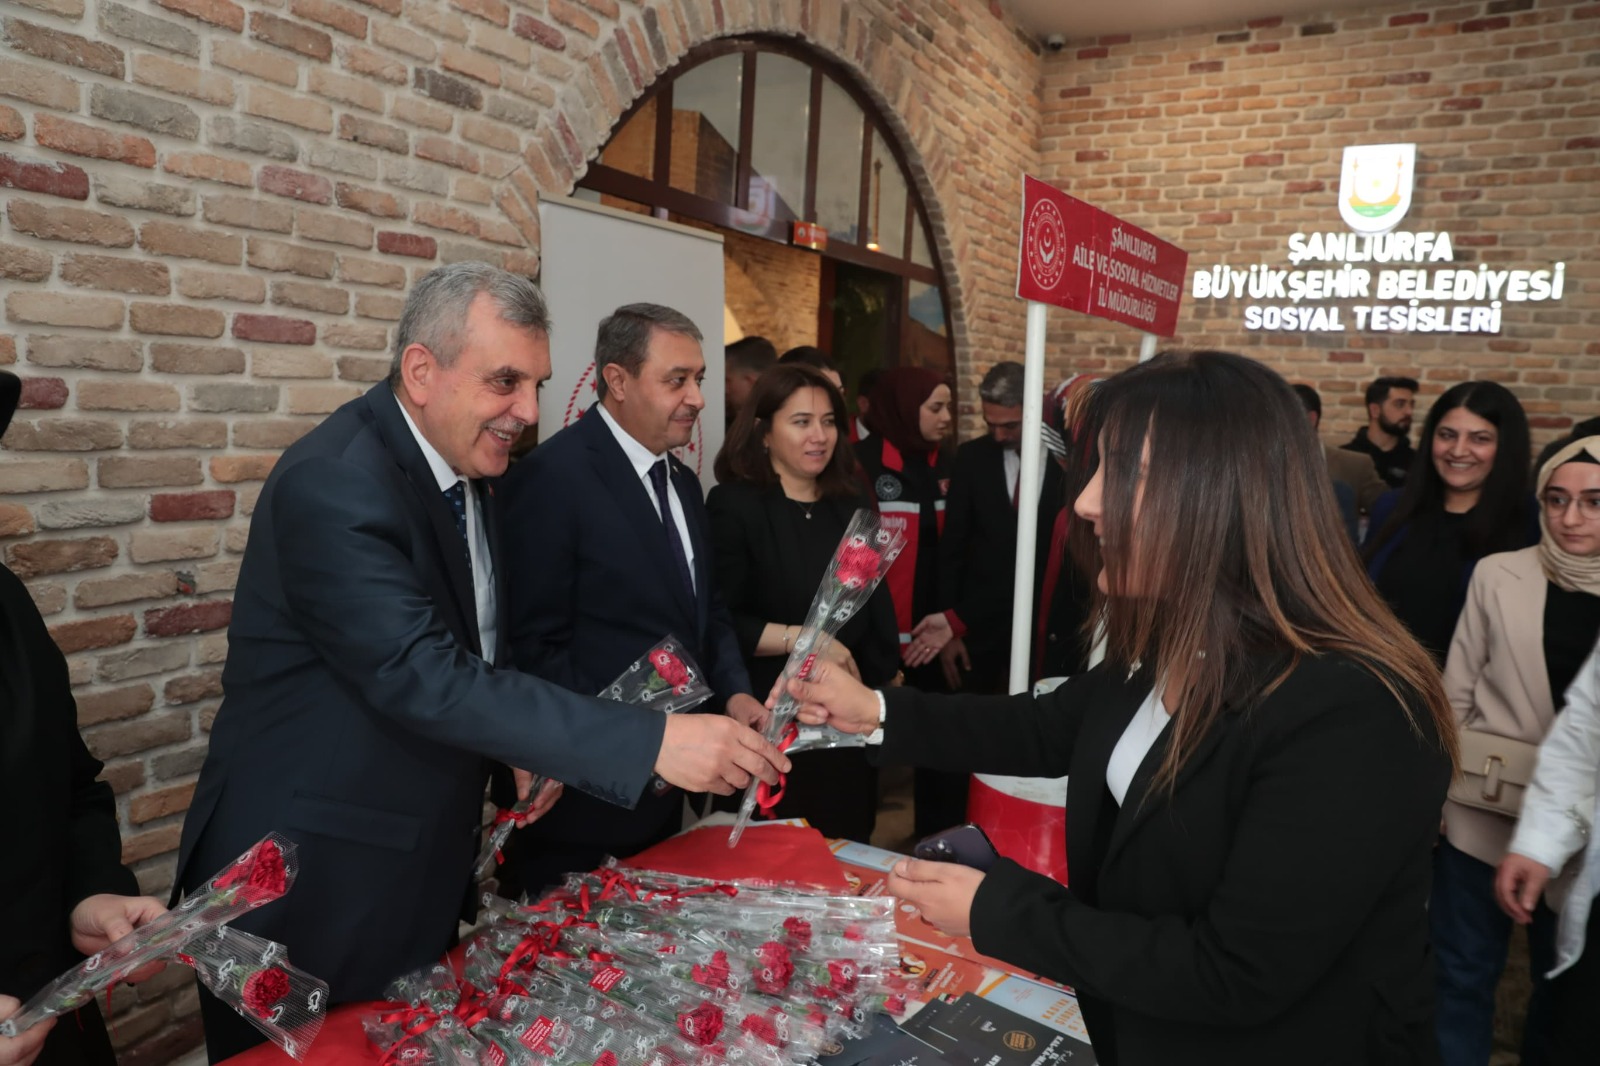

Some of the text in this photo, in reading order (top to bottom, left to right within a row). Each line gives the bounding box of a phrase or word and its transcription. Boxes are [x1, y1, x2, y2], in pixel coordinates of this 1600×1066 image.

[1111, 227, 1157, 264] ŞANLIURFA
[1288, 231, 1454, 266] ŞANLIURFA
[1072, 242, 1095, 270] AİLE
[1096, 253, 1109, 275] VE
[1109, 258, 1140, 289] SOSYAL
[1141, 270, 1180, 303] HİZMETLER
[1192, 262, 1565, 304] BÜYÜKŞEHİR BELEDİYESİ
[1097, 282, 1157, 323] İL MÜDÜRLÜĞÜ
[1245, 299, 1502, 333] SOSYAL TESİSLERİ
